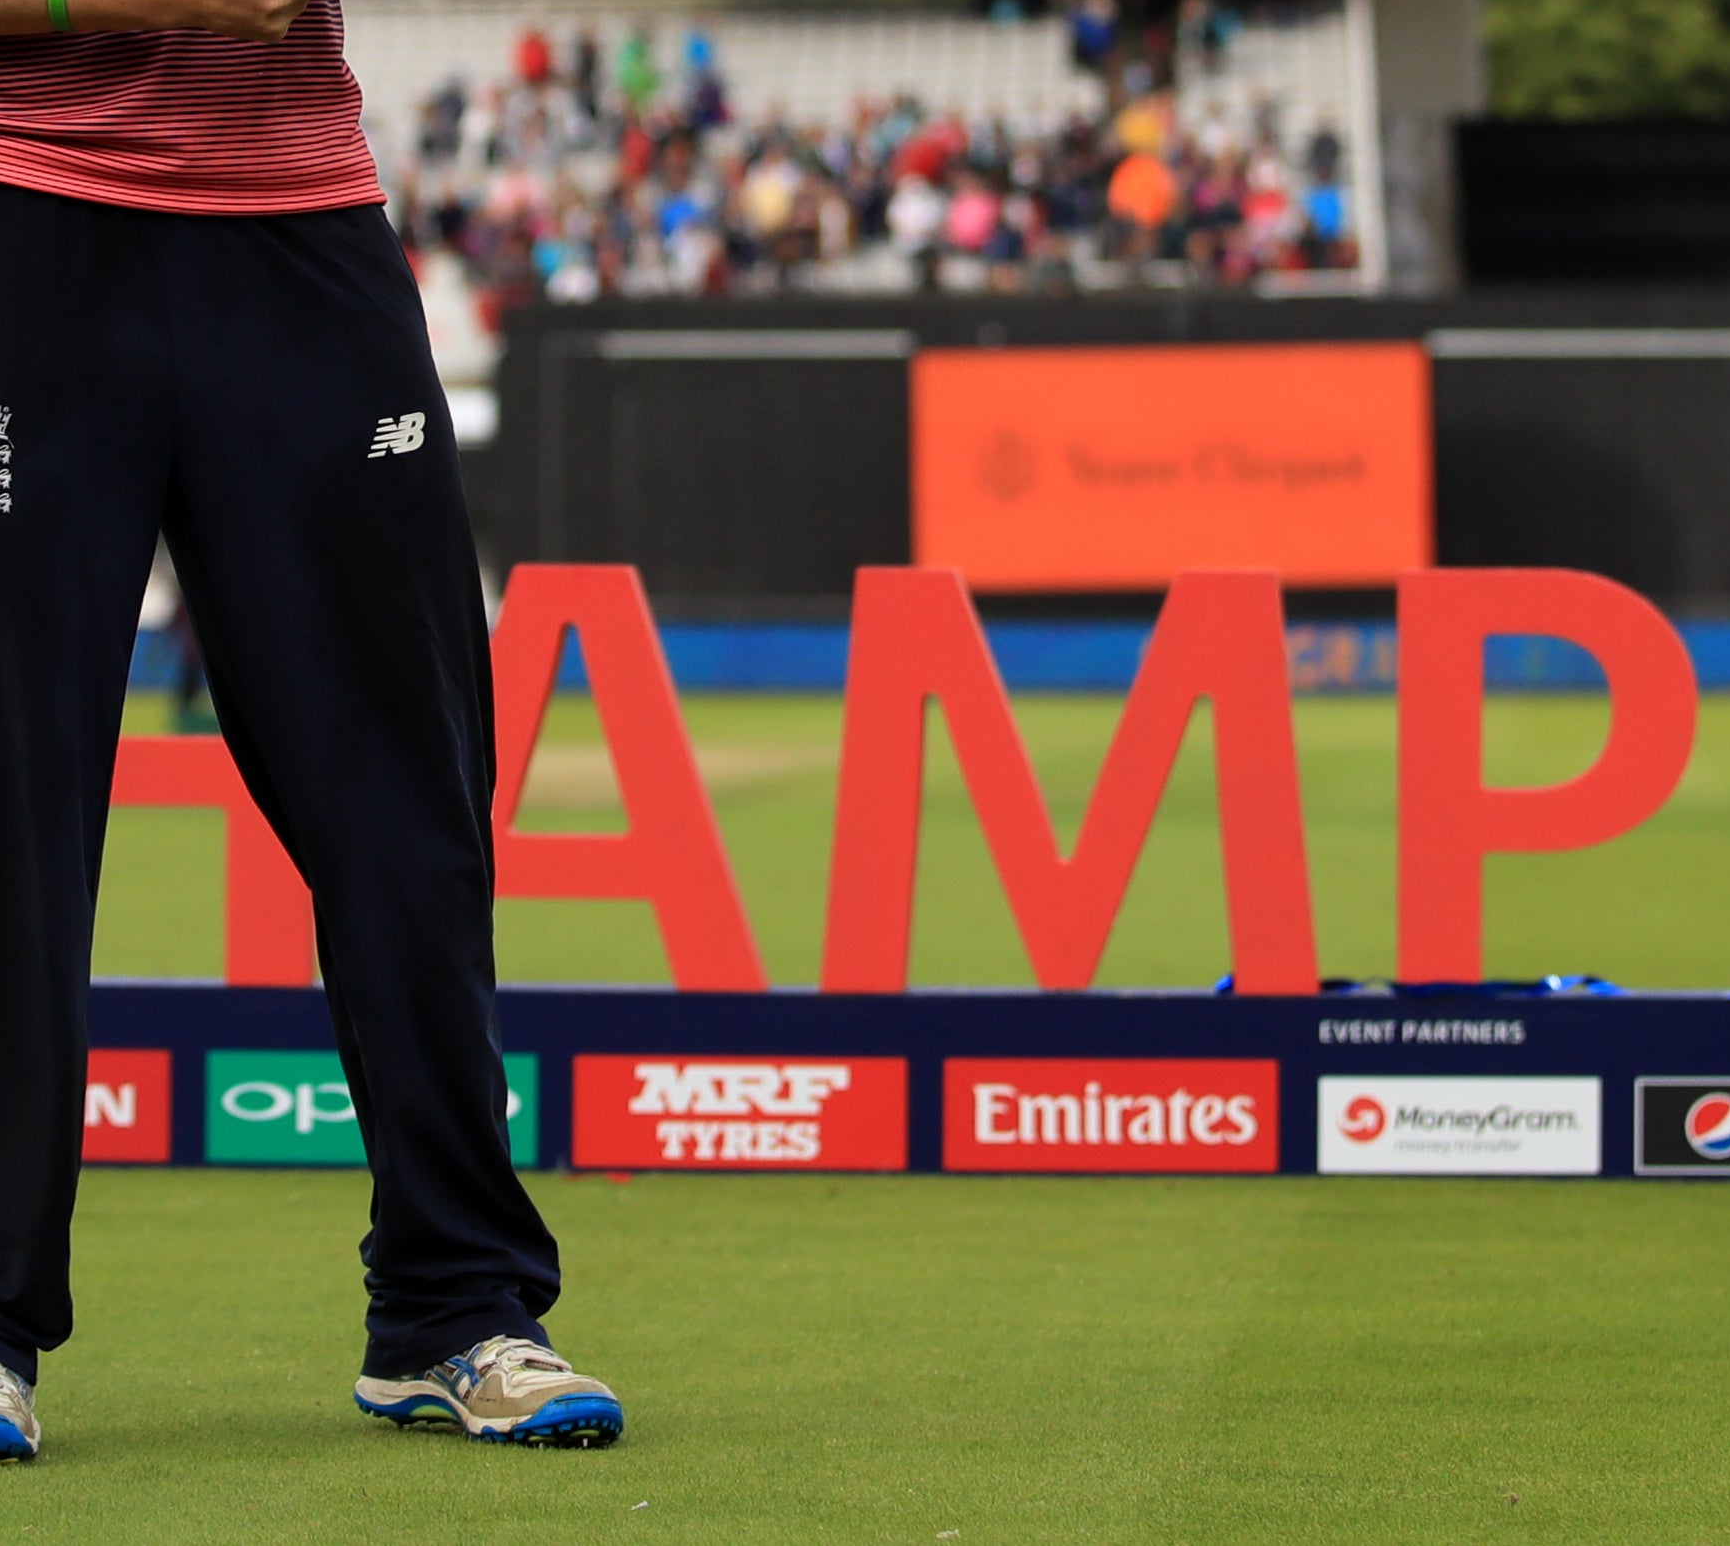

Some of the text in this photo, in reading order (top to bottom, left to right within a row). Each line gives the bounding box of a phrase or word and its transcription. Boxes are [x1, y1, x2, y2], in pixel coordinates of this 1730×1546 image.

[1318, 1019, 1527, 1046] EVENT PARTNERS
[628, 1062, 851, 1116] MRF
[972, 1080, 1260, 1146] Emirates
[655, 1120, 821, 1161] TYRES
